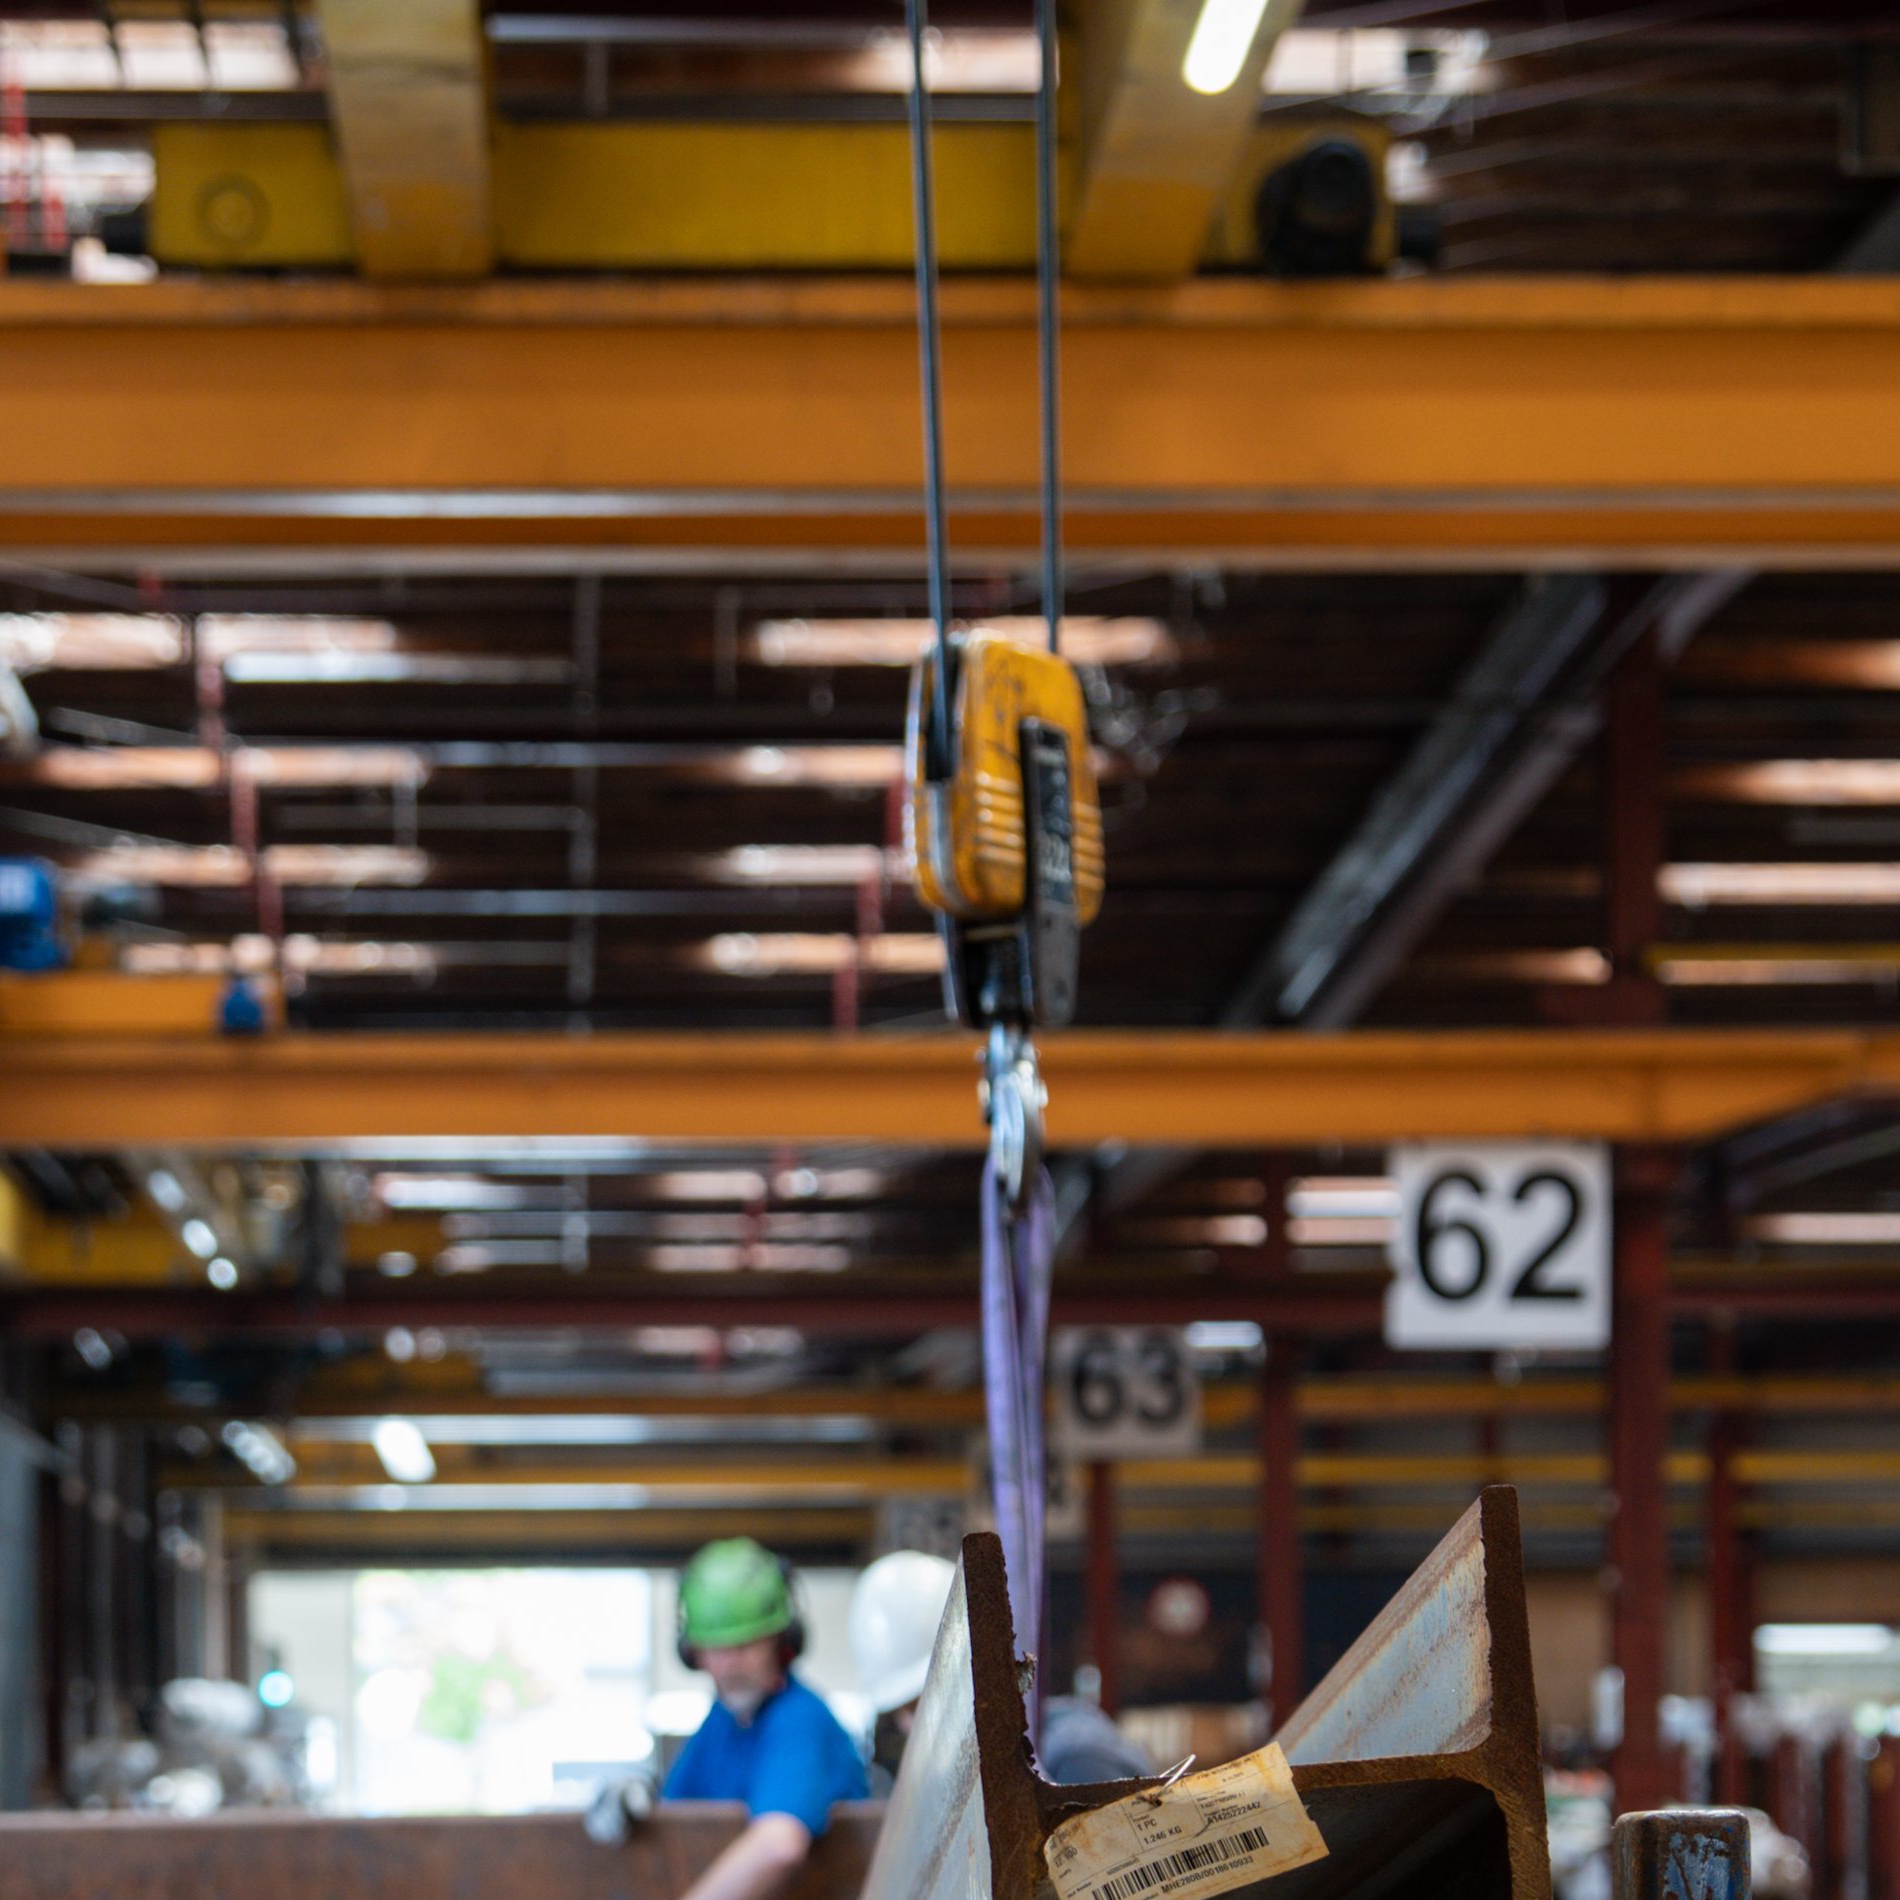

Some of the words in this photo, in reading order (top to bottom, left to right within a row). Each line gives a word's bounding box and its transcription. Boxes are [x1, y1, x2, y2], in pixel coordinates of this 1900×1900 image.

[1415, 1167, 1588, 1302] 62
[1071, 1334, 1183, 1429] 63
[1207, 1801, 1261, 1824] A1425222442
[1137, 1823, 1143, 1831] 1
[1143, 1818, 1157, 1830] PC
[1143, 1831, 1167, 1845] 1.246
[1168, 1825, 1182, 1836] KG
[1055, 1847, 1078, 1868] 12.100
